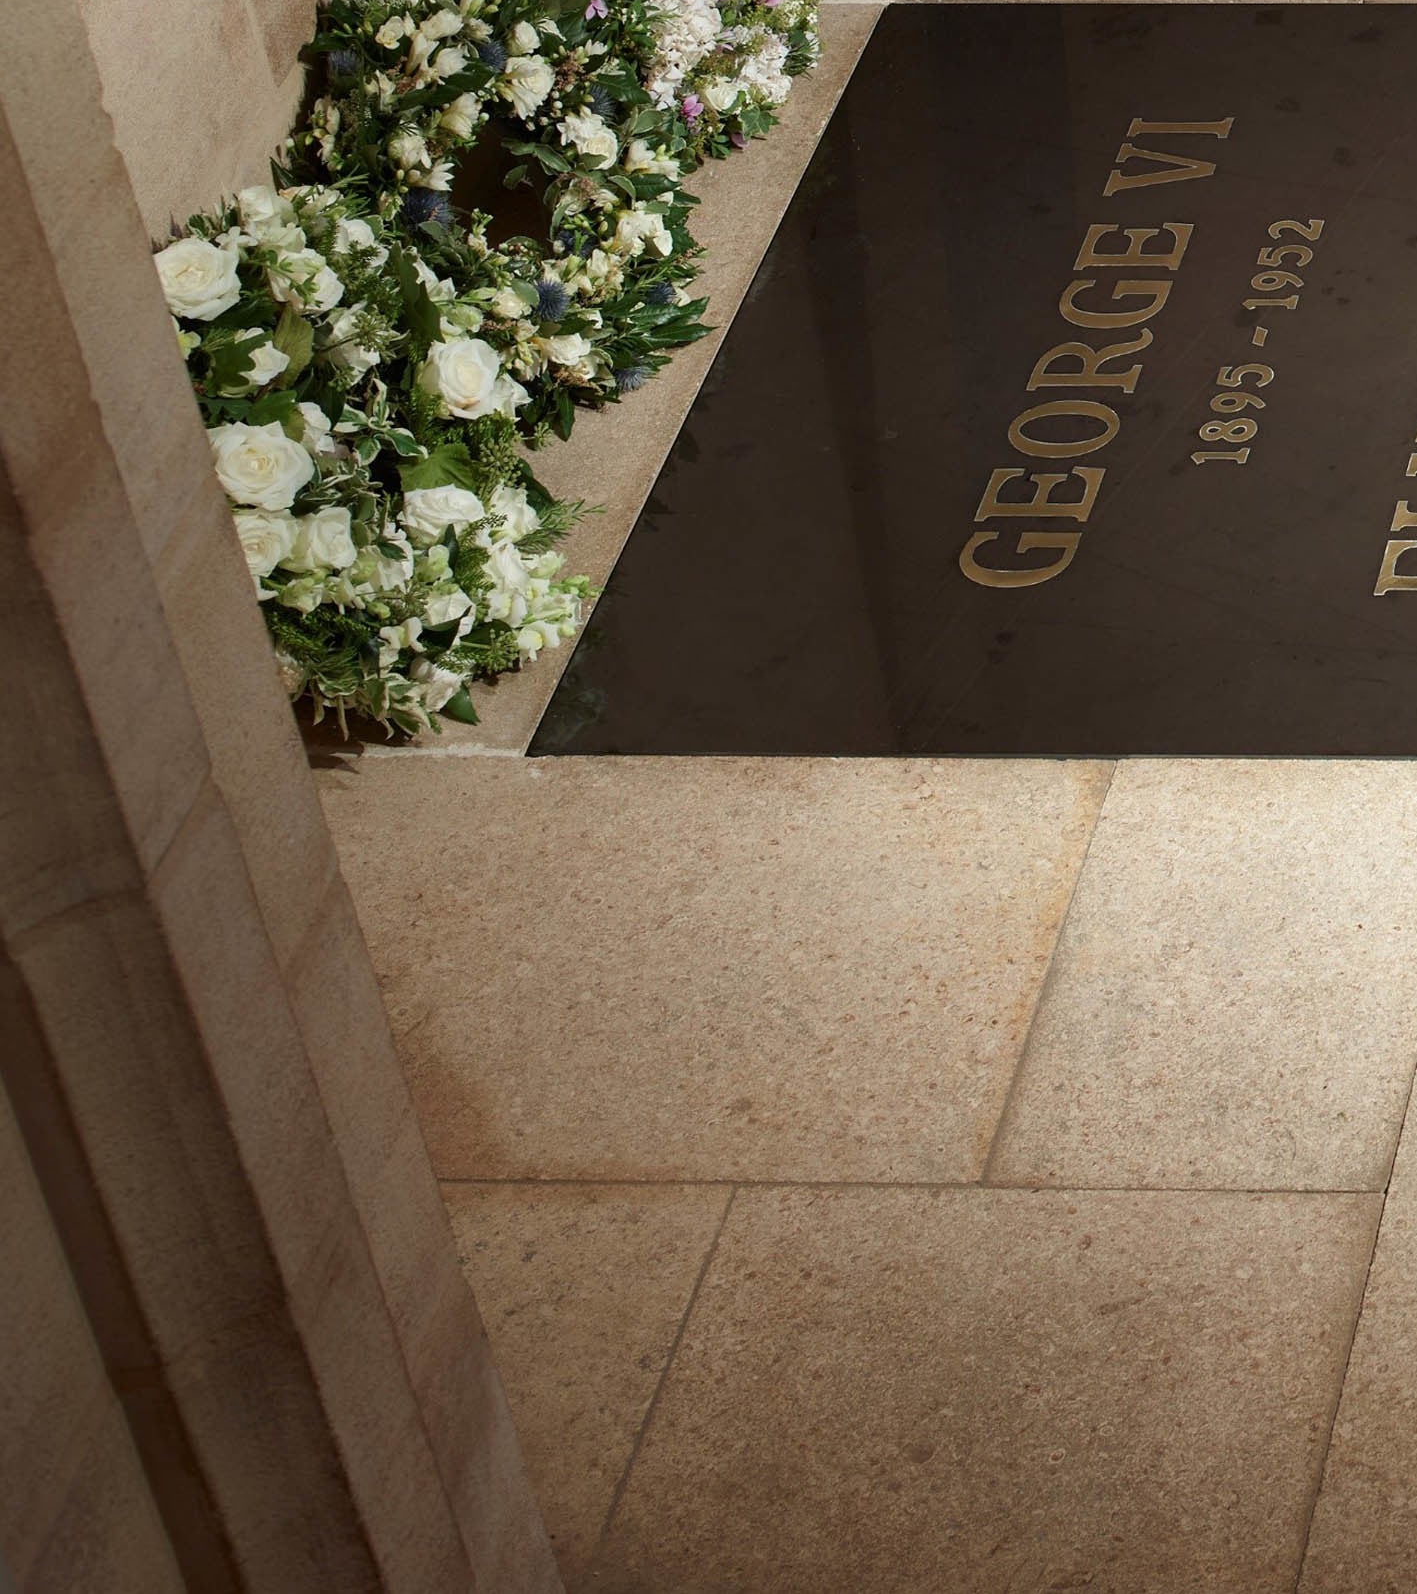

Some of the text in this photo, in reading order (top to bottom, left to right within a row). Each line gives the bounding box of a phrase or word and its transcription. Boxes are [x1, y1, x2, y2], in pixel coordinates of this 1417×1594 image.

[960, 117, 1234, 588] GEORGE VI
[1190, 218, 1325, 466] 1895 - 1952
